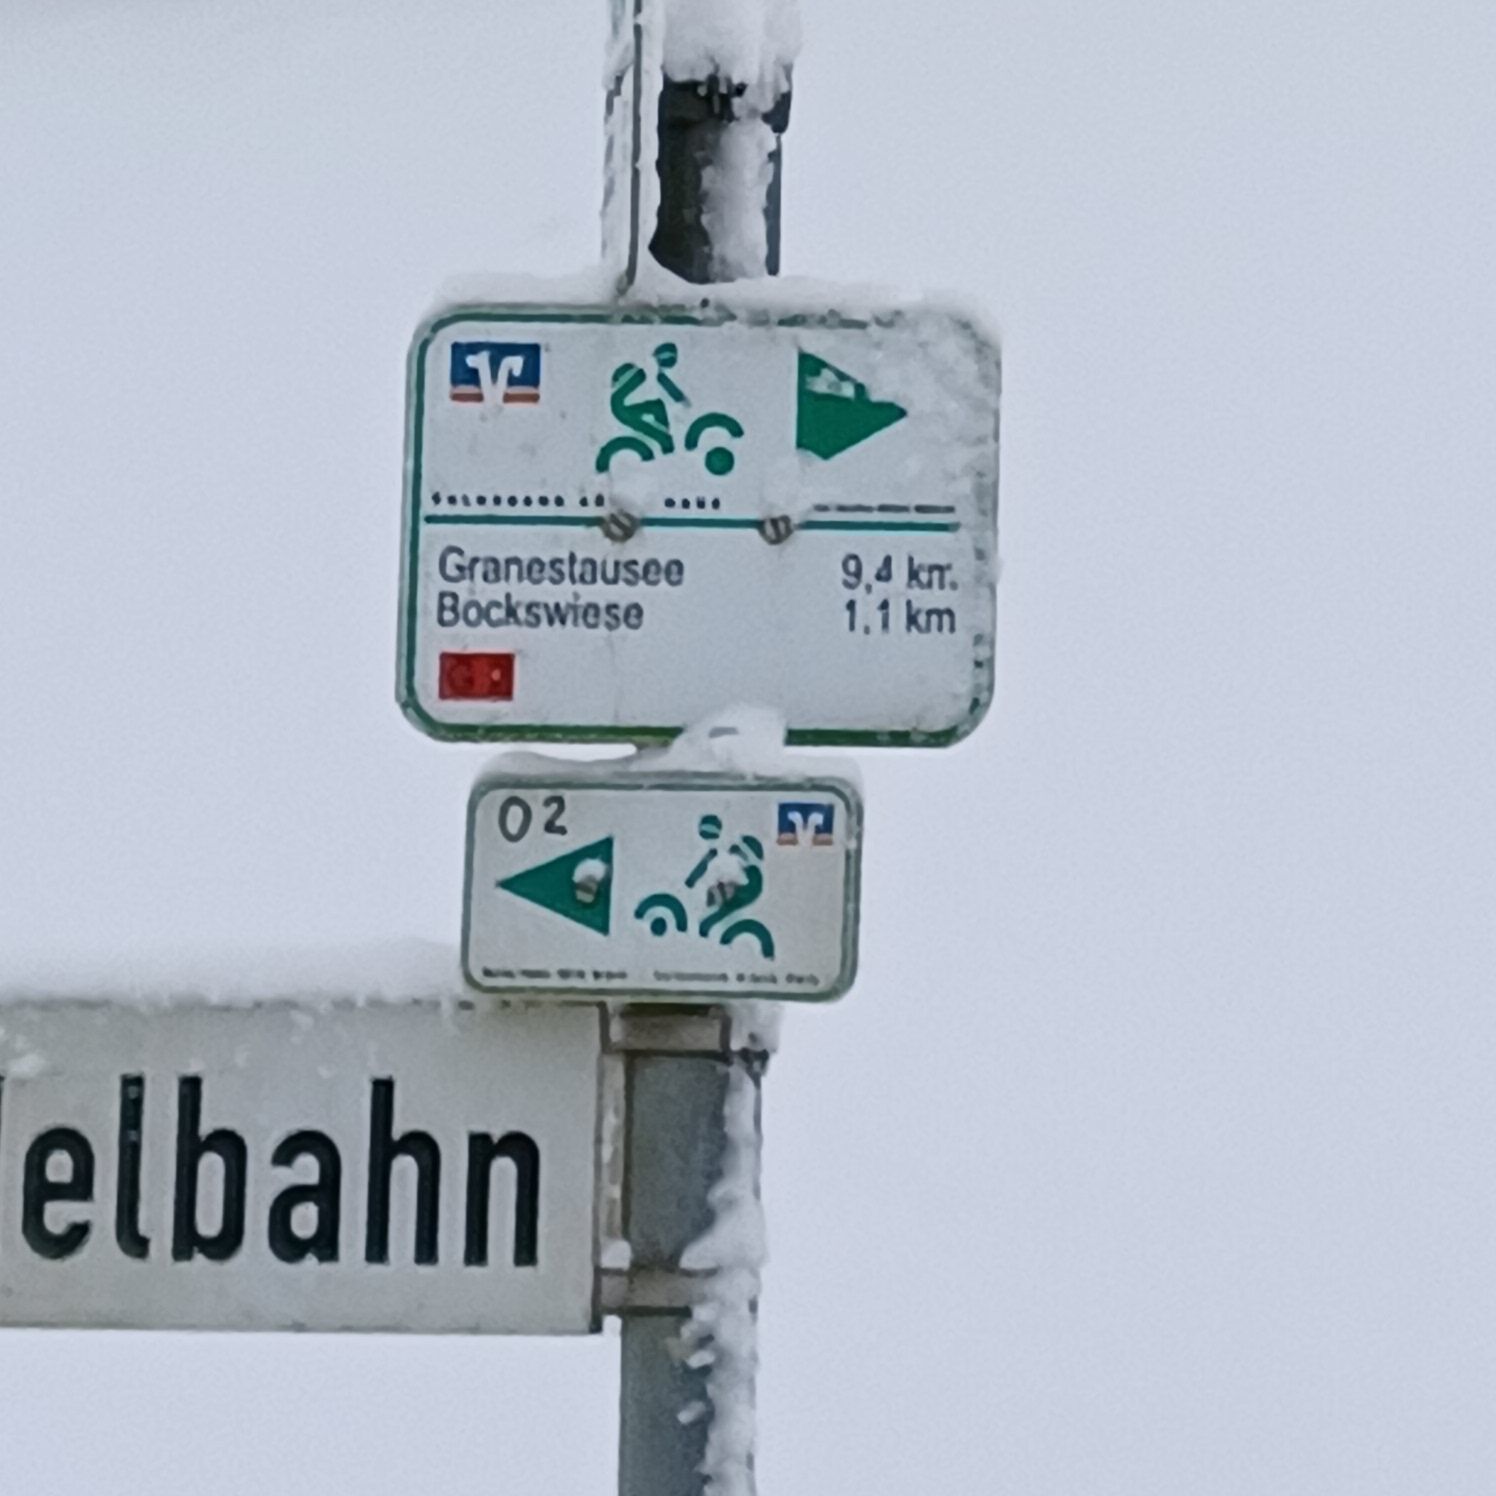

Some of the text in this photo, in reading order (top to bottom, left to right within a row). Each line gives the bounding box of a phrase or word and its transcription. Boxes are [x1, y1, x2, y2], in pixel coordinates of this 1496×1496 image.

[438, 544, 685, 587] Granestausee
[841, 553, 893, 595] 9,4
[436, 590, 644, 632] Bockswiese
[905, 598, 957, 635] km
[0, 1073, 541, 1268] elbahn
